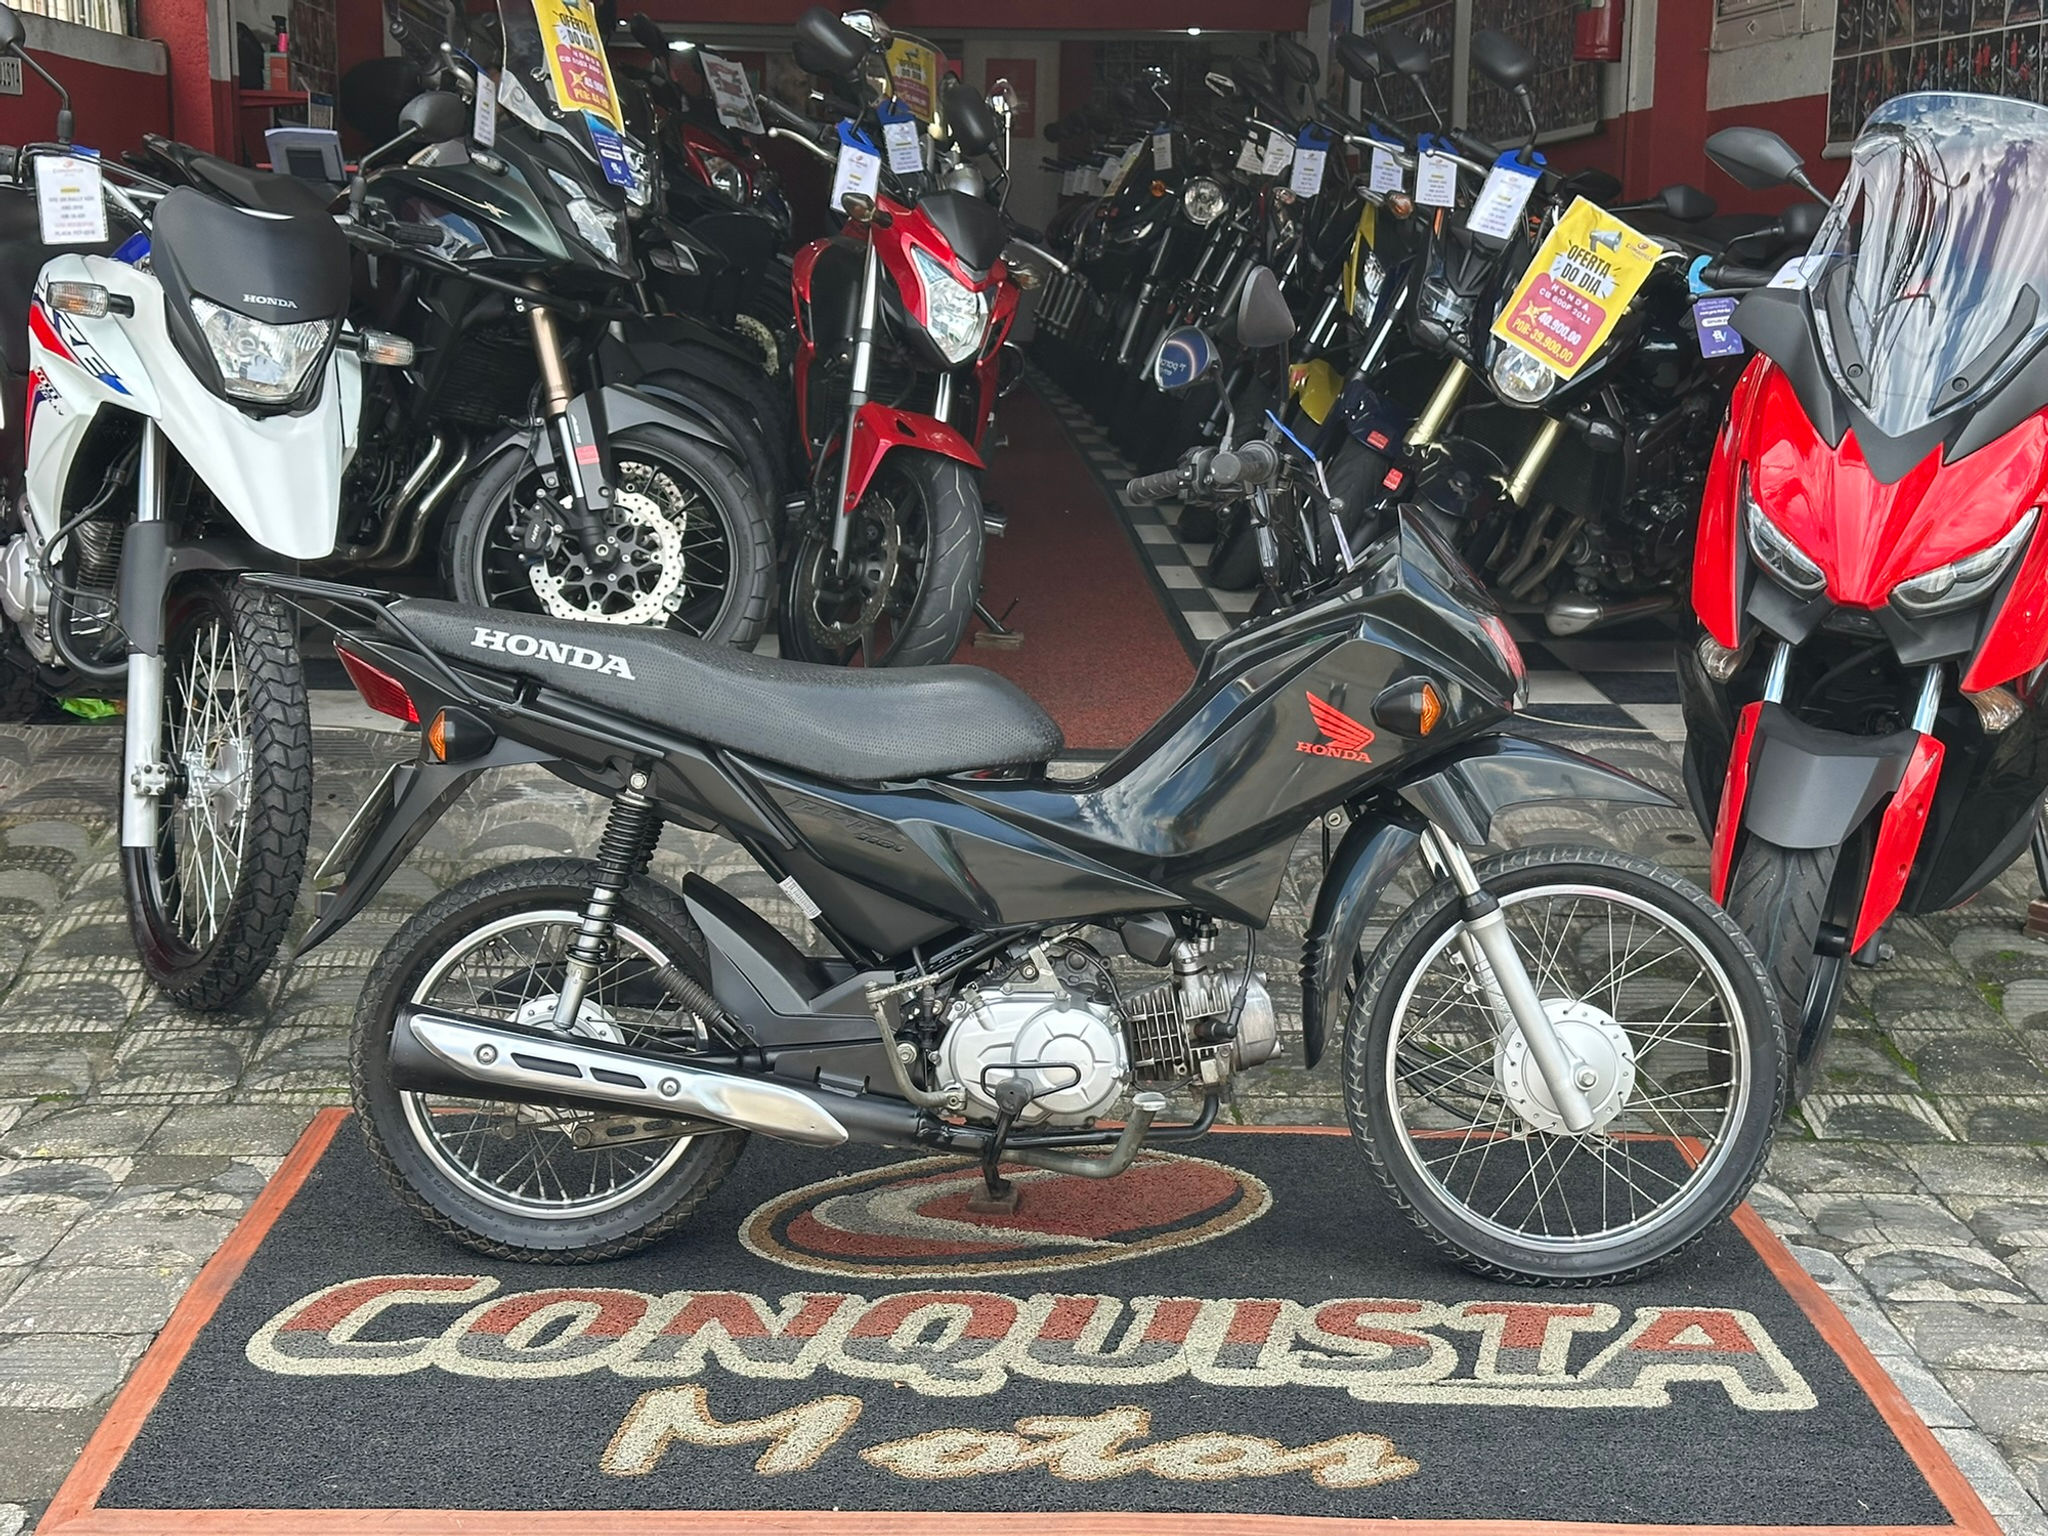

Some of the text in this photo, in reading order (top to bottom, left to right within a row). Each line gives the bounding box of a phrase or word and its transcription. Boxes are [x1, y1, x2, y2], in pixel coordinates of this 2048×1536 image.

[1561, 263, 1602, 296] DO DIA
[1567, 245, 1611, 279] OFERTA
[243, 294, 298, 309] HONDA
[1539, 288, 1552, 298] CB
[1572, 308, 1591, 325] 2011
[1551, 283, 1590, 311] HONDA
[1512, 317, 1573, 362] POR: 39.900,00
[471, 626, 636, 681] HONDA
[1295, 741, 1373, 764] HONDA
[245, 1273, 1818, 1411] CONQUISTA
[599, 1382, 1421, 1489] Motos
